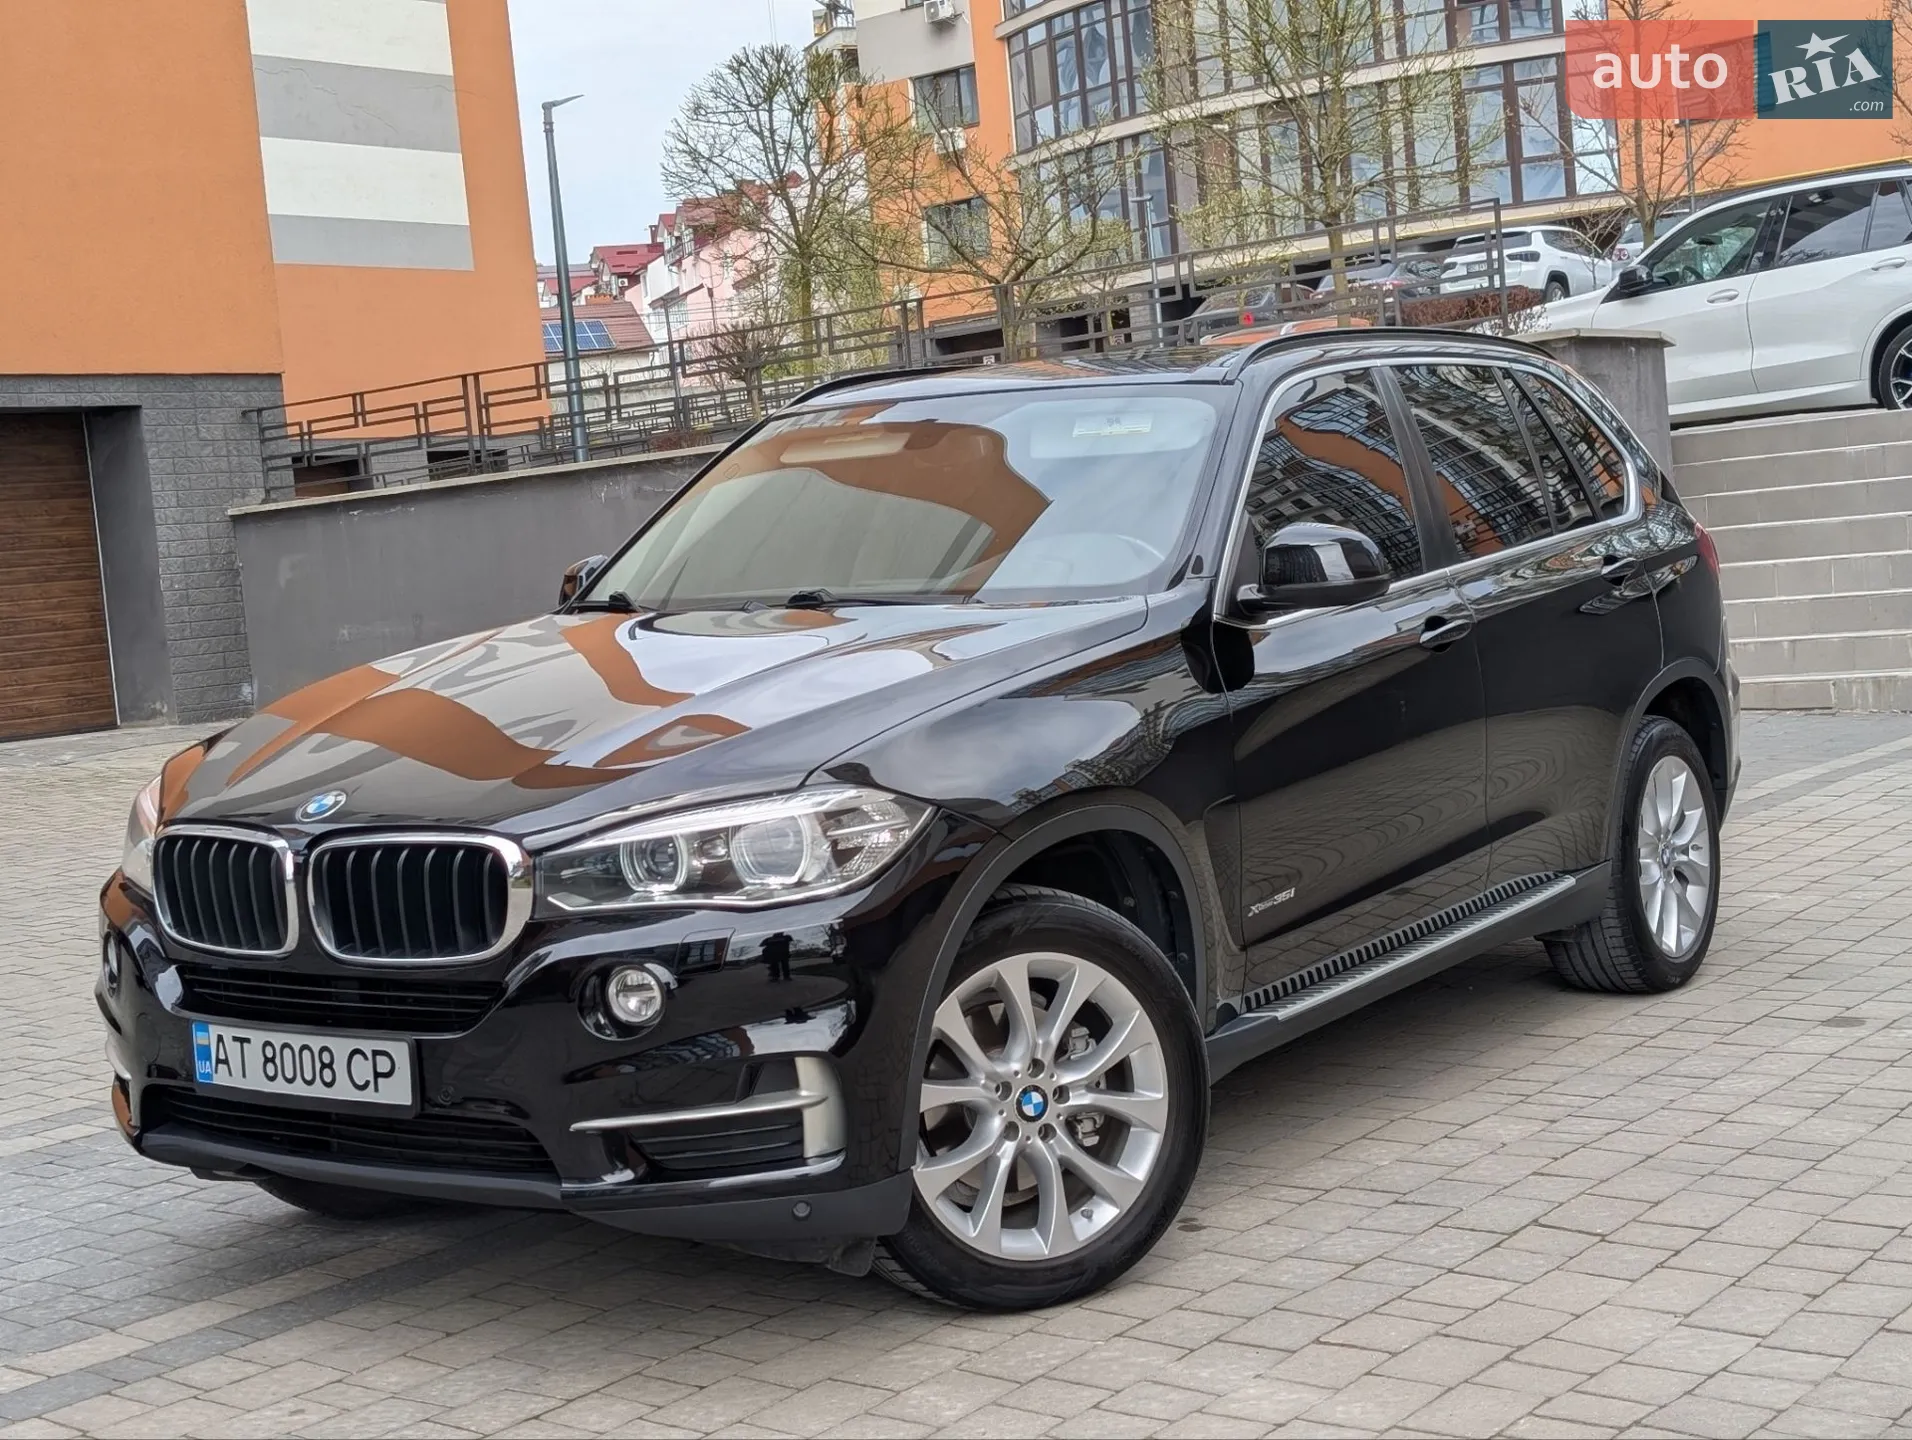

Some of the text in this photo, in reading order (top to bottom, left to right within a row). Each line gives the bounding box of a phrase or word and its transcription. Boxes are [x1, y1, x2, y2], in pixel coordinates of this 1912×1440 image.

[198, 1060, 212, 1074] UA
[215, 1033, 396, 1093] AT 8008 CP
